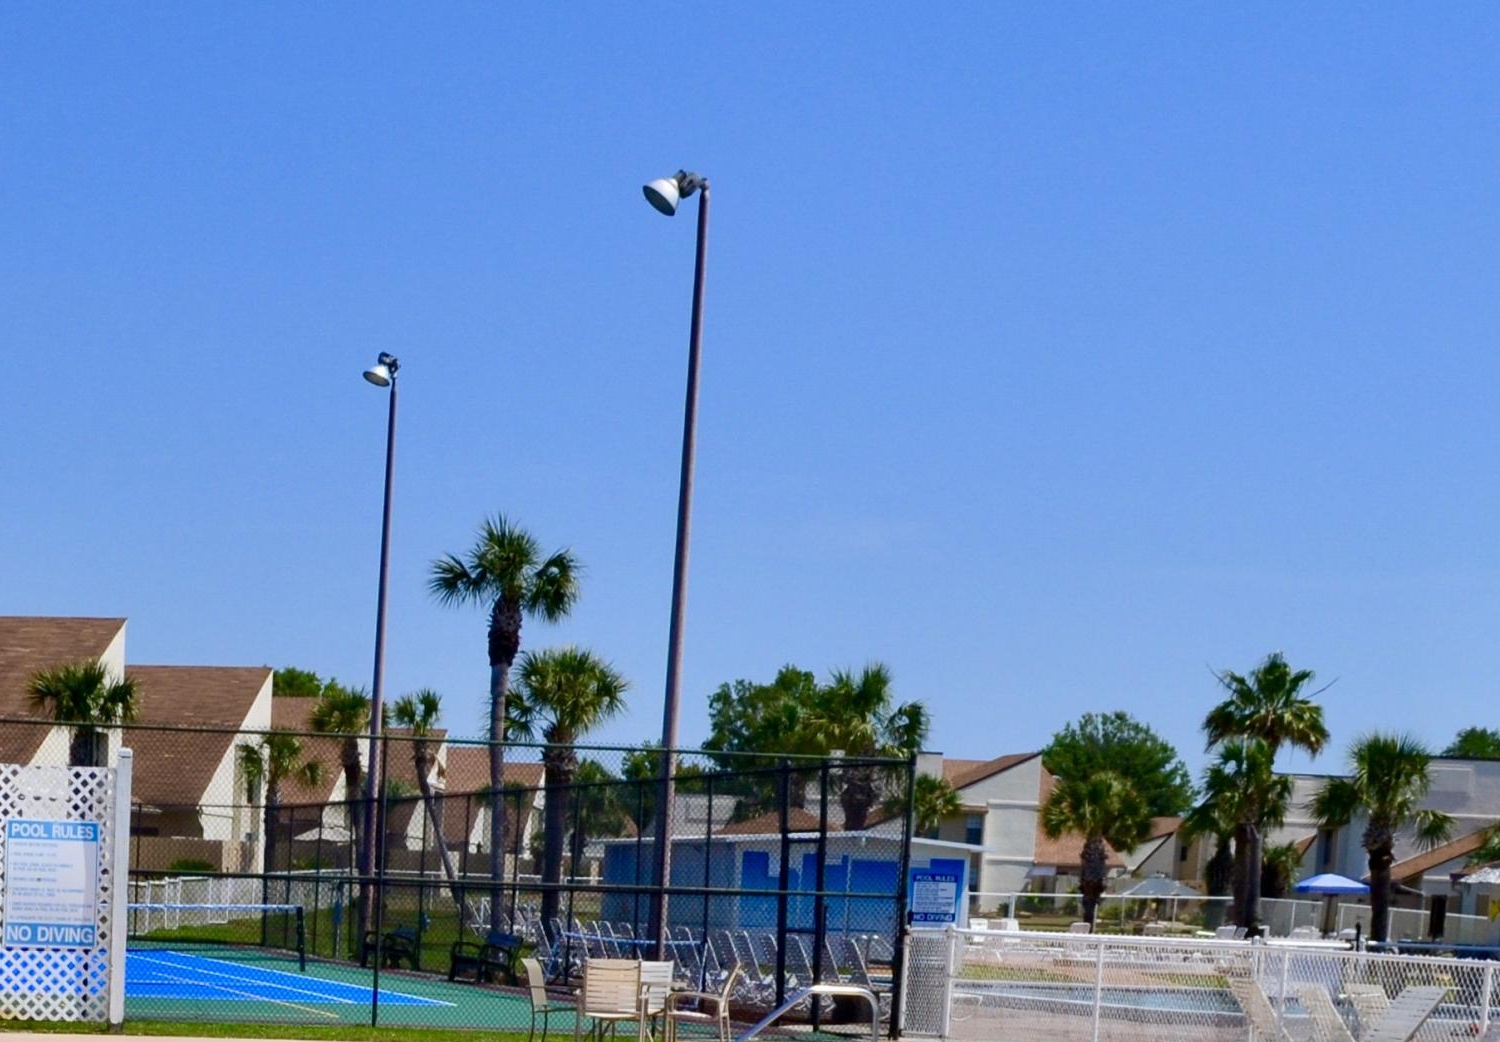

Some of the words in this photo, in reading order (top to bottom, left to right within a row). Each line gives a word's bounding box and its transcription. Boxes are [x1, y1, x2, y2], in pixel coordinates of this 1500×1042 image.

[11, 823, 48, 839] POOL
[52, 824, 94, 840] RULES
[914, 913, 925, 921] NO
[6, 925, 32, 942] NO
[37, 925, 94, 944] DIVING
